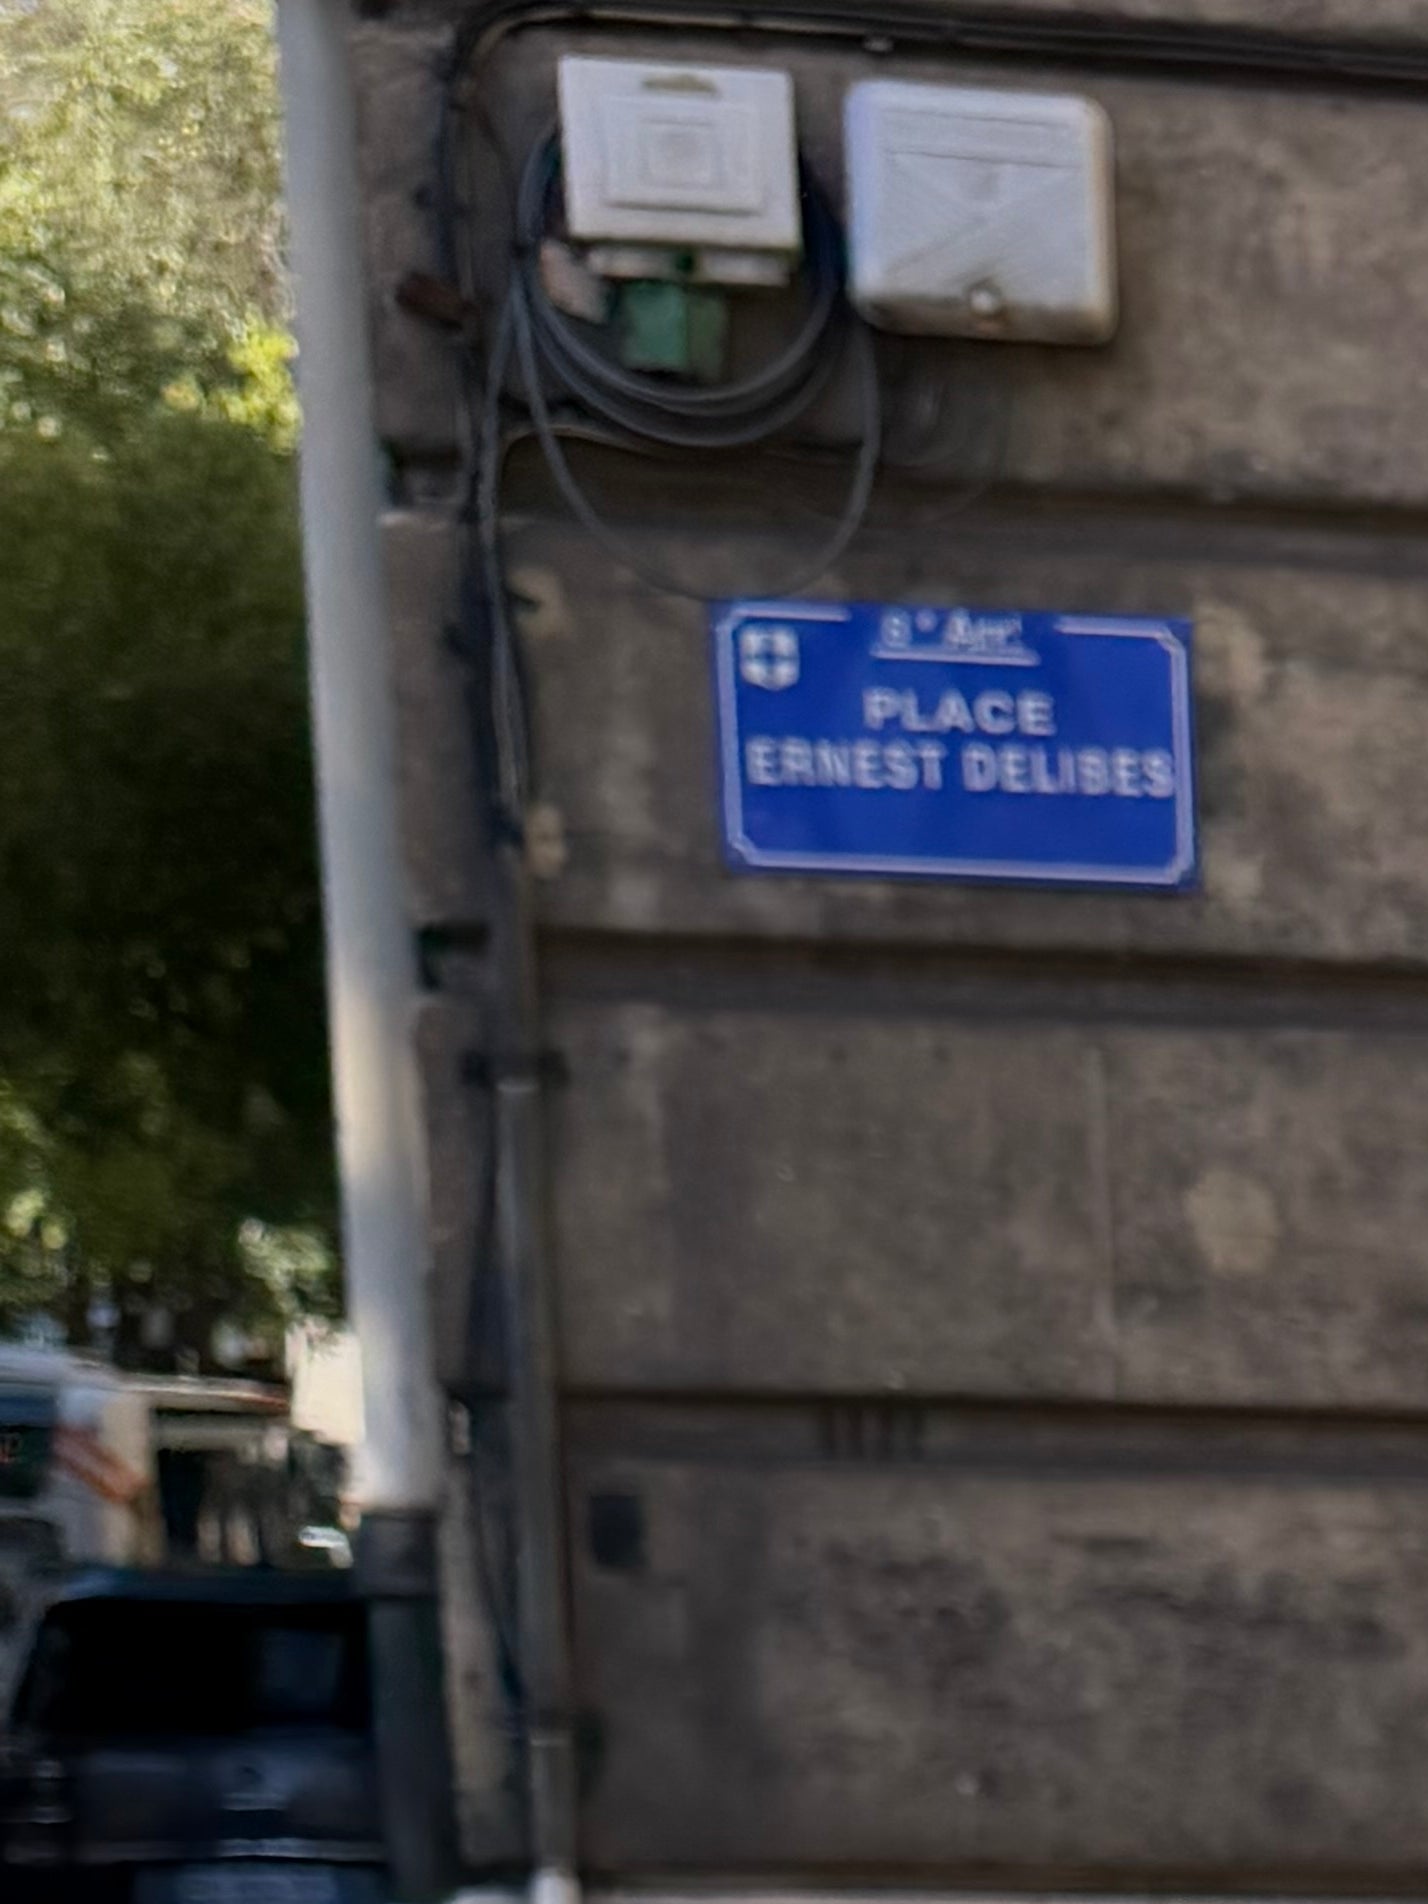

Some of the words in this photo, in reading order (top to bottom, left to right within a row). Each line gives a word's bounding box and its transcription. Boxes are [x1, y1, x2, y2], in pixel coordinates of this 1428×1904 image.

[862, 687, 1057, 736] PLACE
[745, 736, 948, 790] ERNEST
[961, 742, 1174, 799] DELIBES
